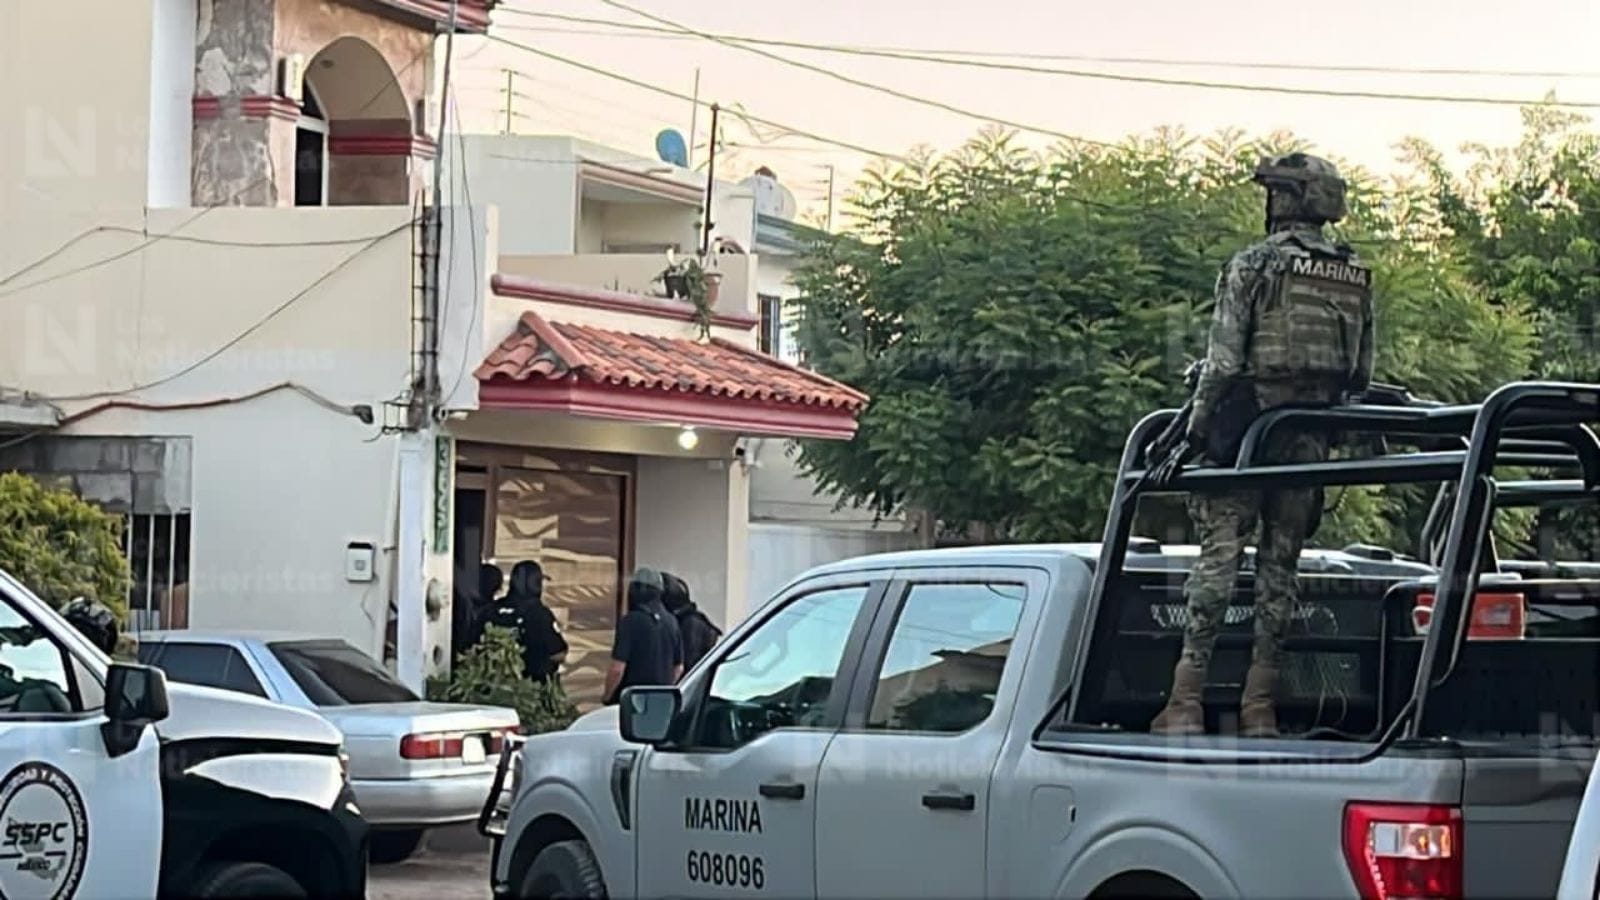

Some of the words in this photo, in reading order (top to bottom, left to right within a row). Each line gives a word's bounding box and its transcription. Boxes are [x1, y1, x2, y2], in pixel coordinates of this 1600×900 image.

[1293, 258, 1367, 286] MARINA
[685, 797, 763, 834] MARINA
[3, 821, 69, 846] SSPC
[687, 849, 765, 890] 608096
